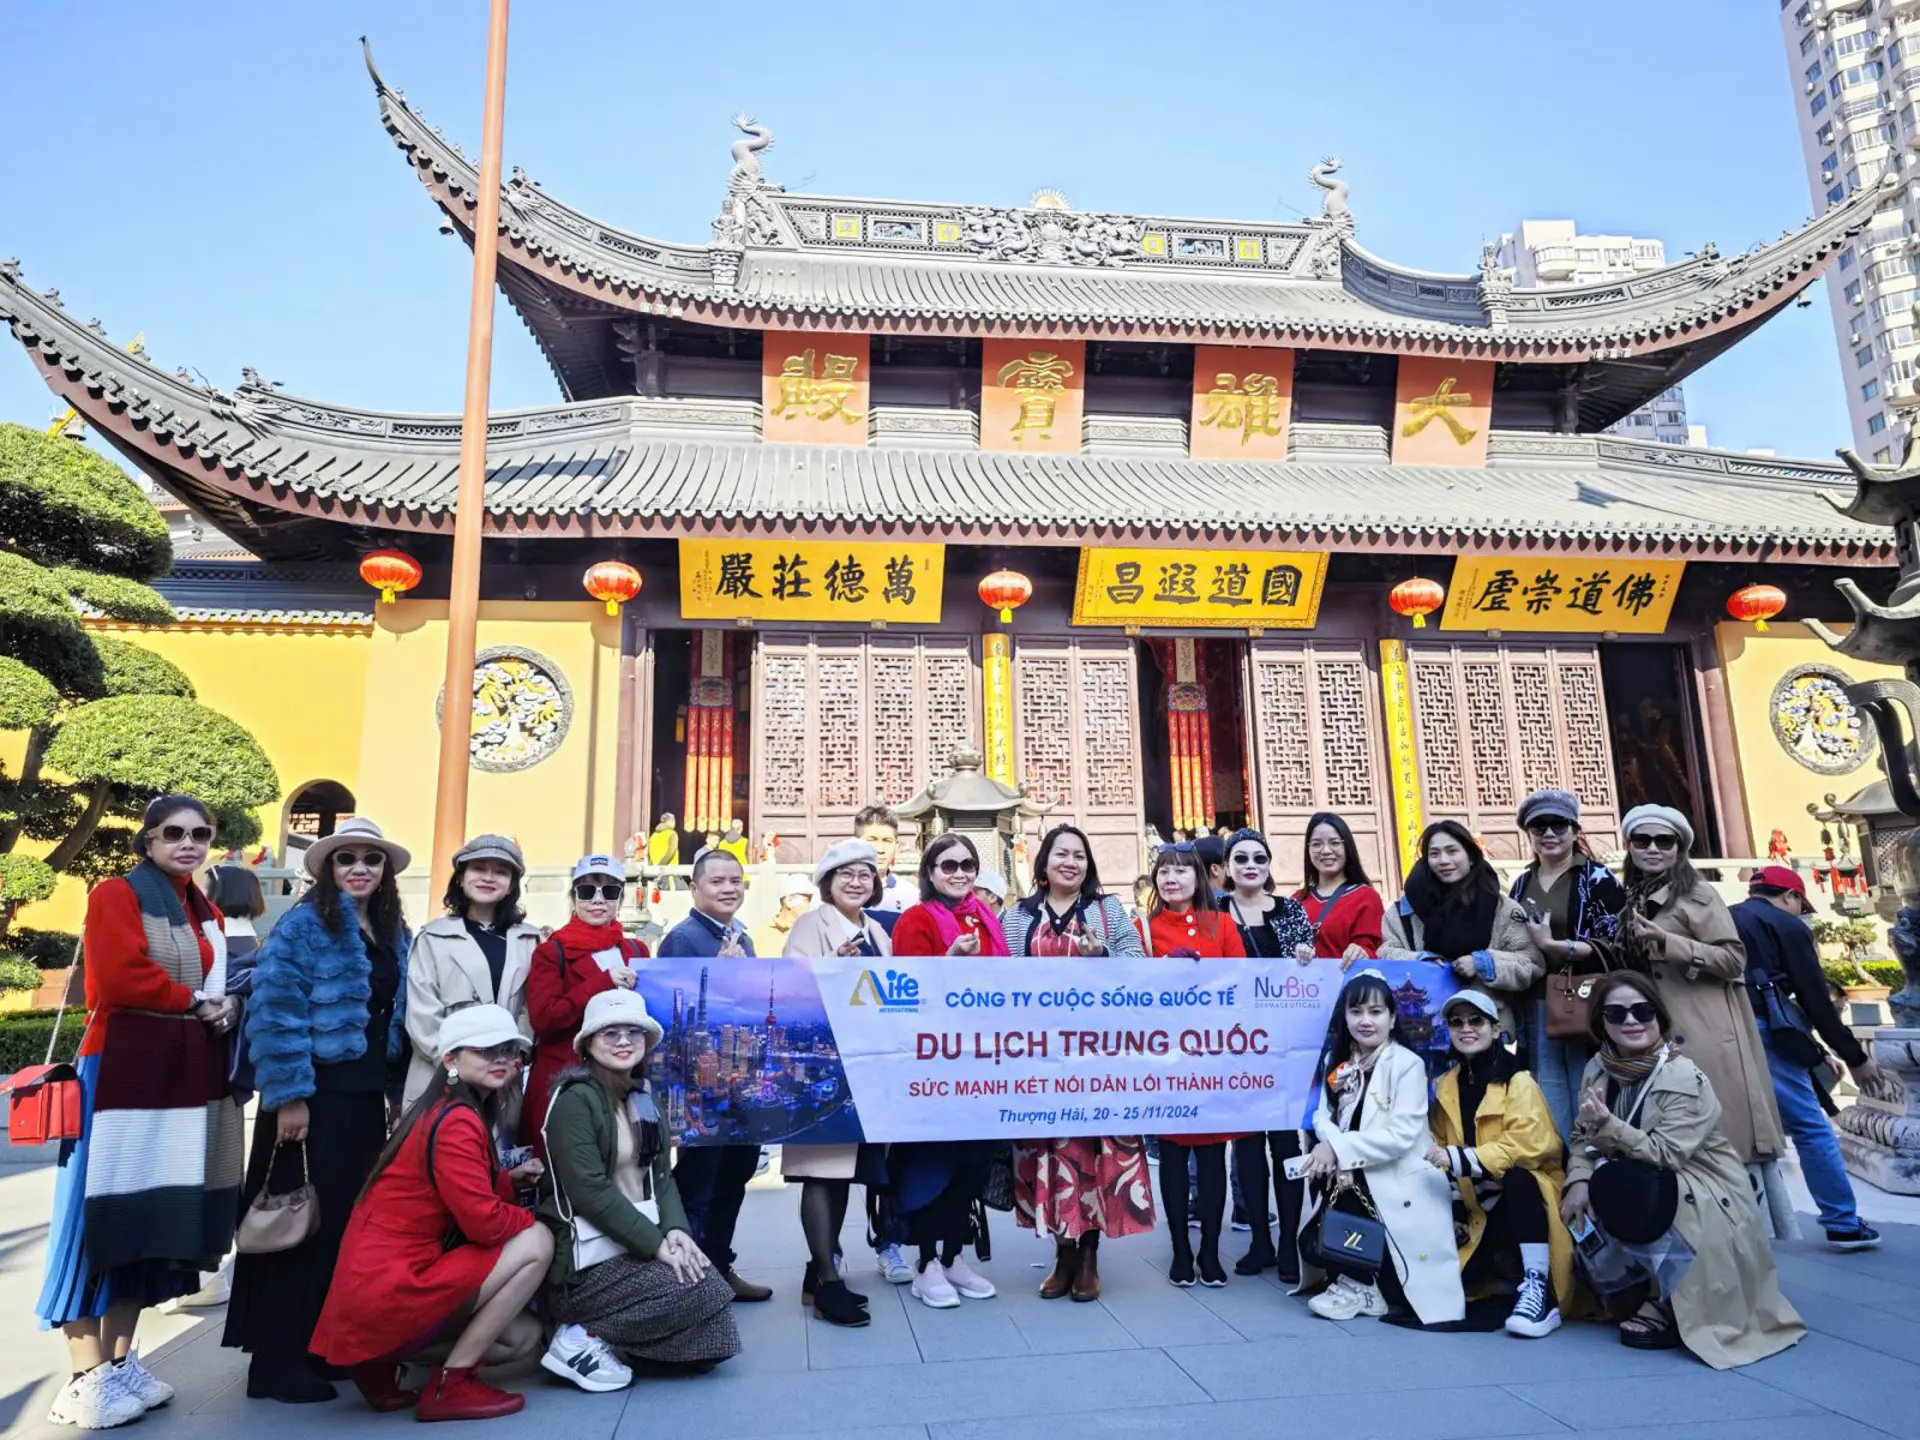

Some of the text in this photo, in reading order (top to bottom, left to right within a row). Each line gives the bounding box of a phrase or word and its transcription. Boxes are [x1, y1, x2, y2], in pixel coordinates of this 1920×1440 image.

[771, 348, 1480, 446] 大 雄 寶 殿
[945, 984, 1239, 1012] CÔNG TY CUỘC SỐNG QUỐC TẾ
[916, 1023, 1269, 1066] DU LỊCH TRUNG QUỐC
[909, 1077, 949, 1097] SỨC
[955, 1079, 1008, 1099] MẠNH
[1054, 1075, 1085, 1093] NỐI
[1133, 1073, 1161, 1092] LỐI
[1228, 1072, 1274, 1090] CÔNG
[998, 1109, 1057, 1125] Thượng
[1093, 1107, 1110, 1121] 20
[1123, 1107, 1140, 1120] 25
[1142, 1105, 1199, 1120] /11/2024
